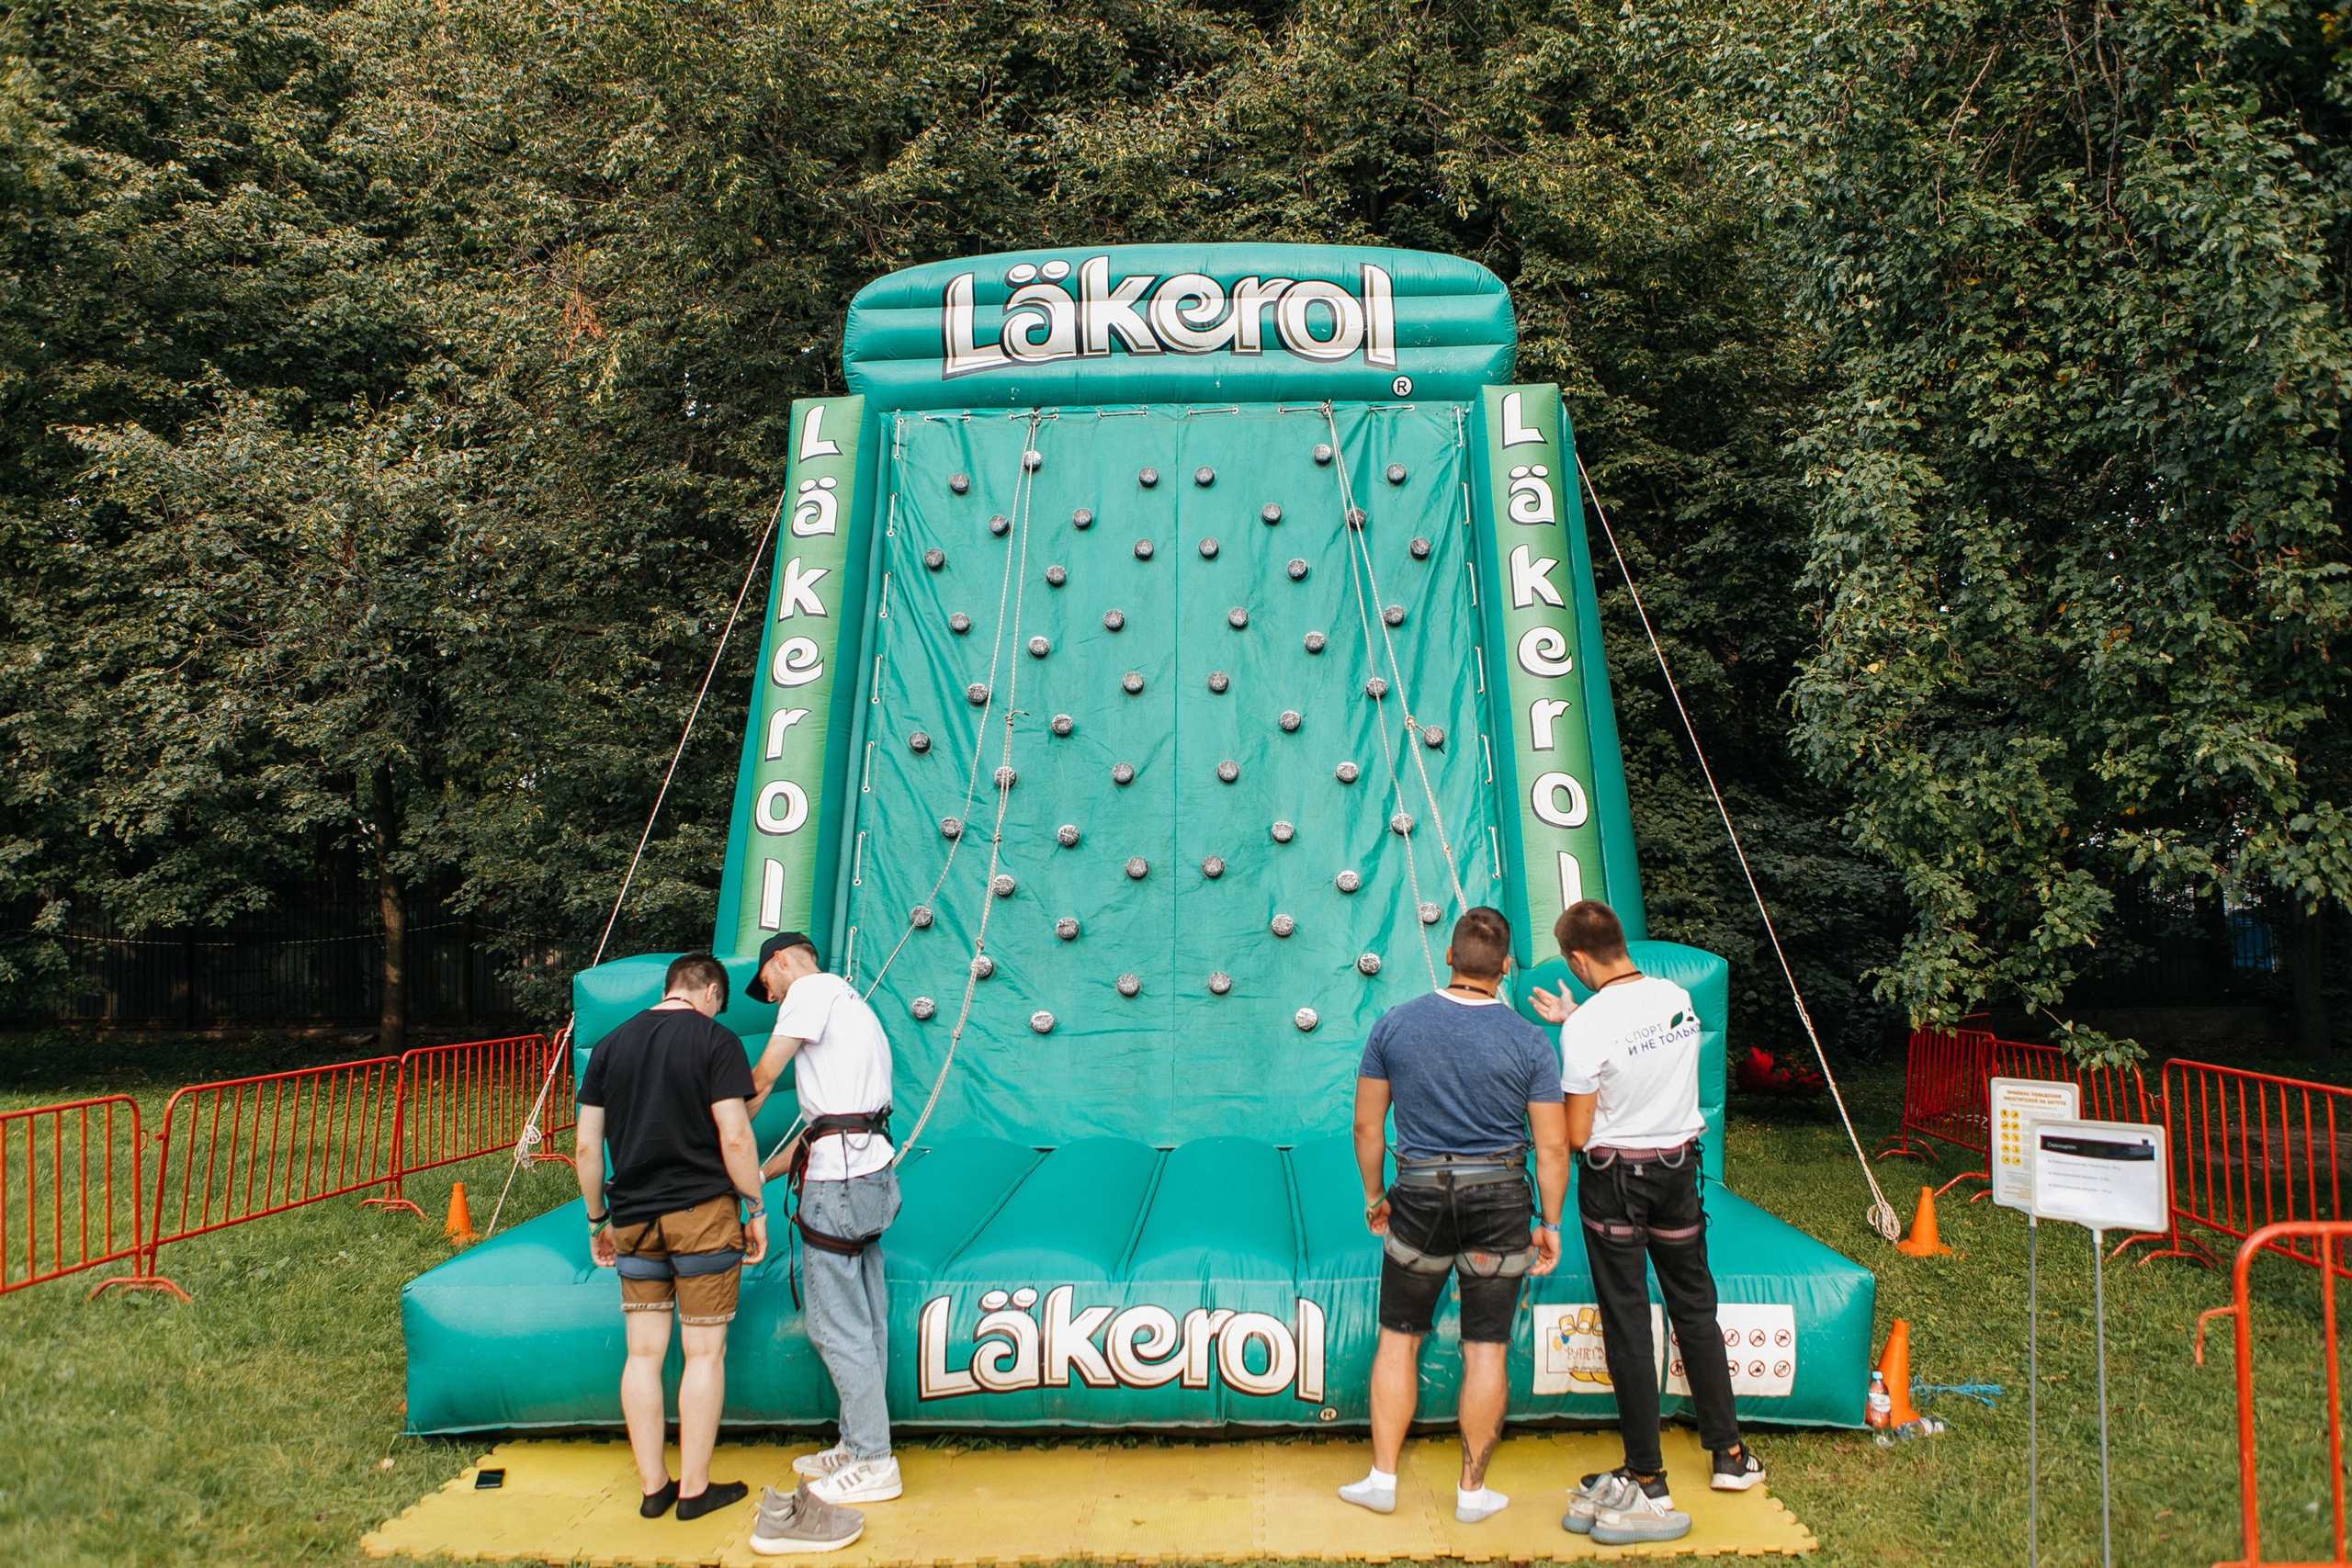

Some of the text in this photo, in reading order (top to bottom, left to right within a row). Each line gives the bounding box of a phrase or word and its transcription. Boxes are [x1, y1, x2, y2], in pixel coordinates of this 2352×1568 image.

[942, 255, 1397, 380] Läkerol
[754, 404, 844, 931] Läkerol
[1501, 391, 1589, 912] Läkerol
[1625, 1023, 1663, 1043] СПОРТ
[1628, 1045, 1638, 1056] И
[1641, 1038, 1657, 1053] НЕ
[919, 1285, 1325, 1404] Läkerol
